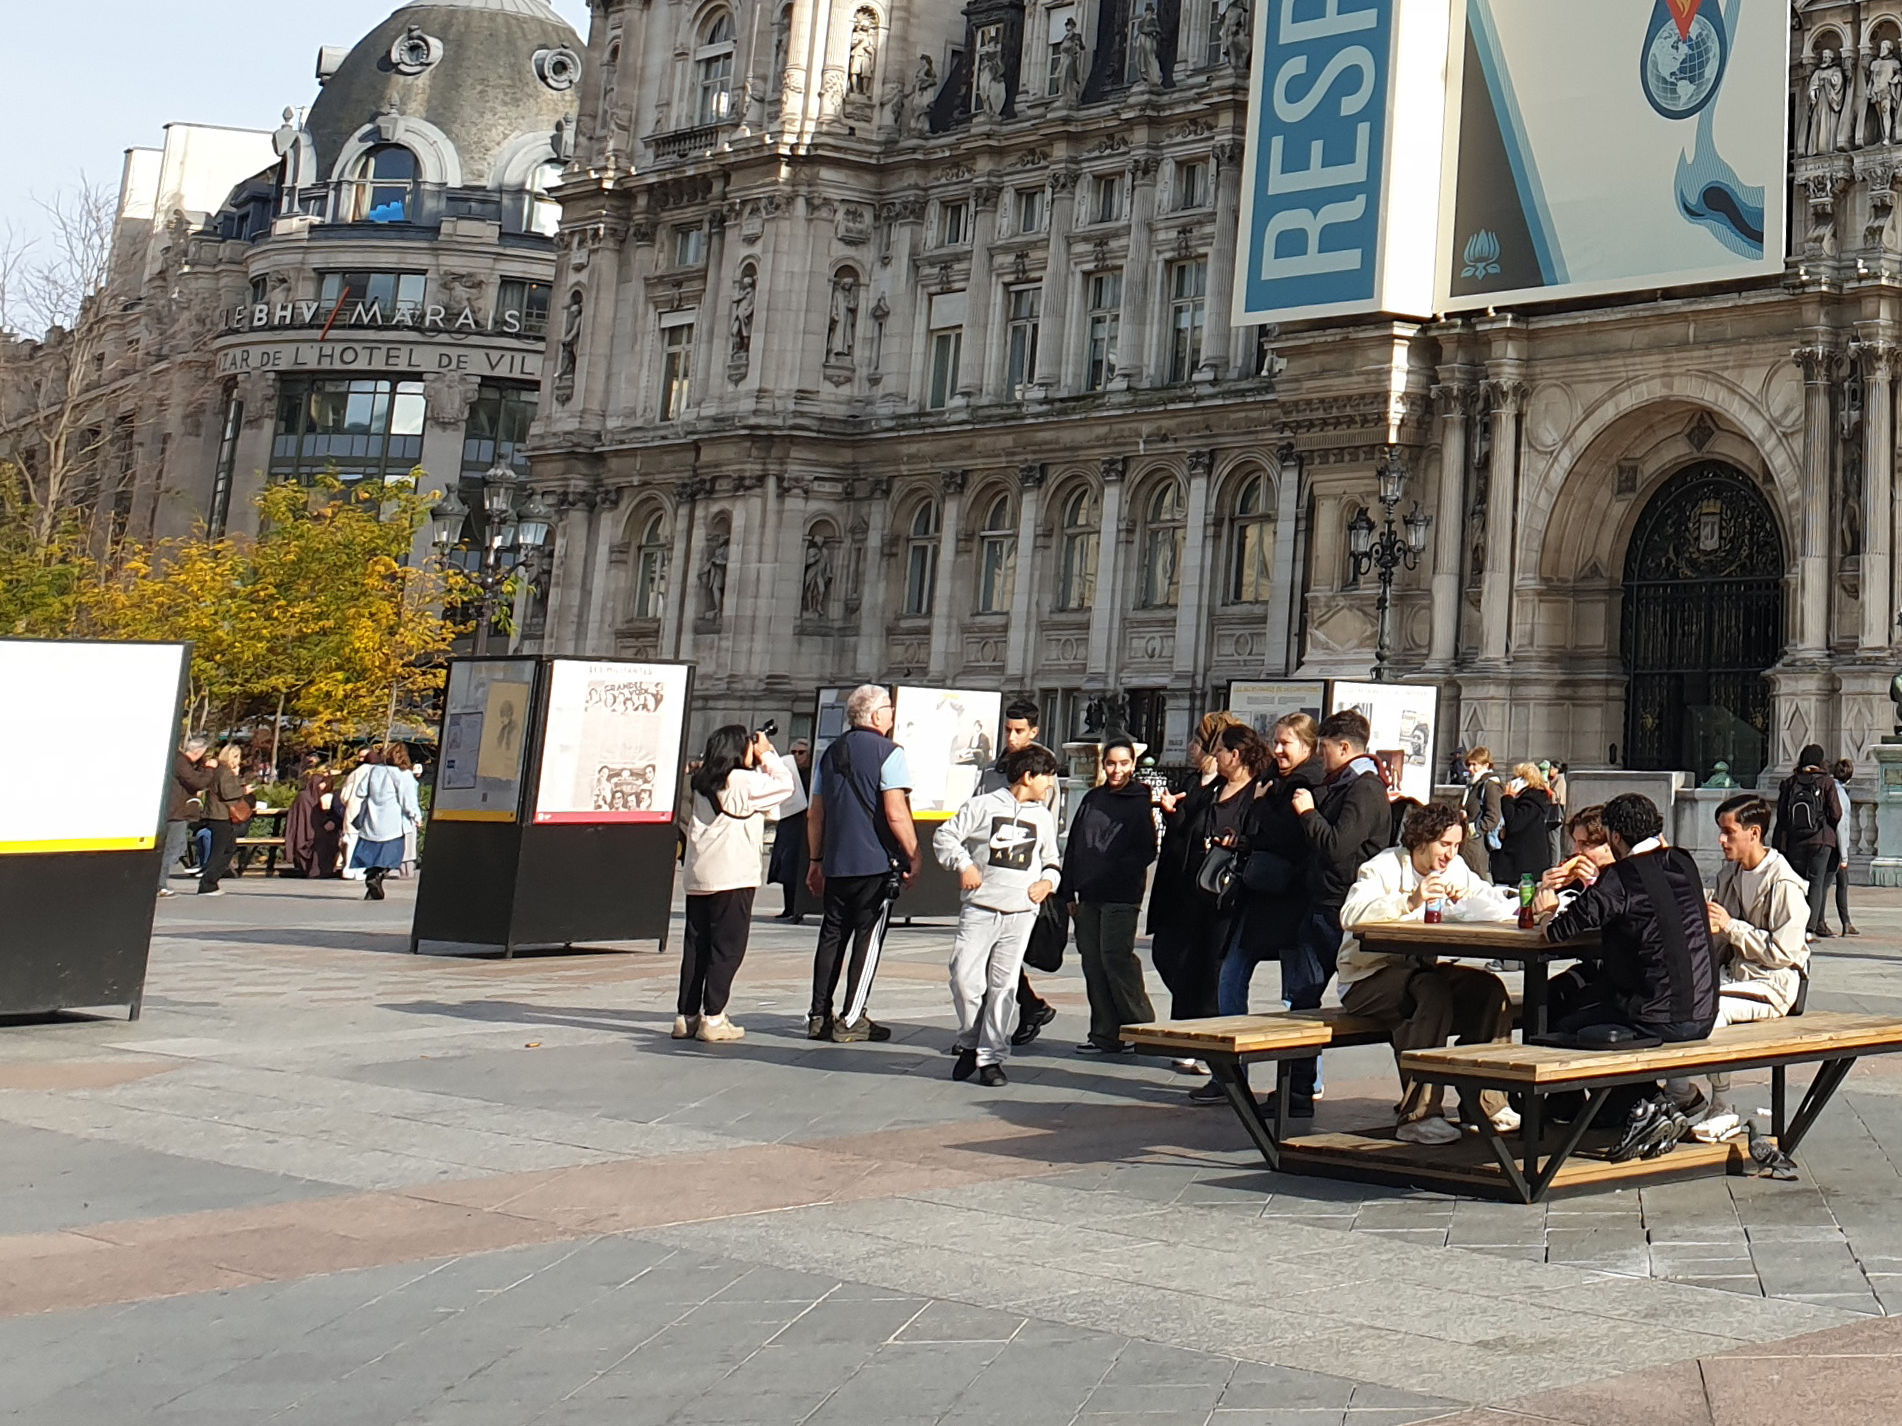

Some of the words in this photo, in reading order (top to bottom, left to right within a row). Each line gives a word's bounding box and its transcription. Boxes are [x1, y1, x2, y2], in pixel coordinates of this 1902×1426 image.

[252, 301, 320, 327] BHV
[350, 301, 521, 333] MARAIS
[218, 349, 250, 372] ZAR
[260, 351, 282, 367] DE
[292, 345, 421, 368] L'HOTEL
[438, 353, 468, 370] DE
[995, 850, 1026, 863] AIR
